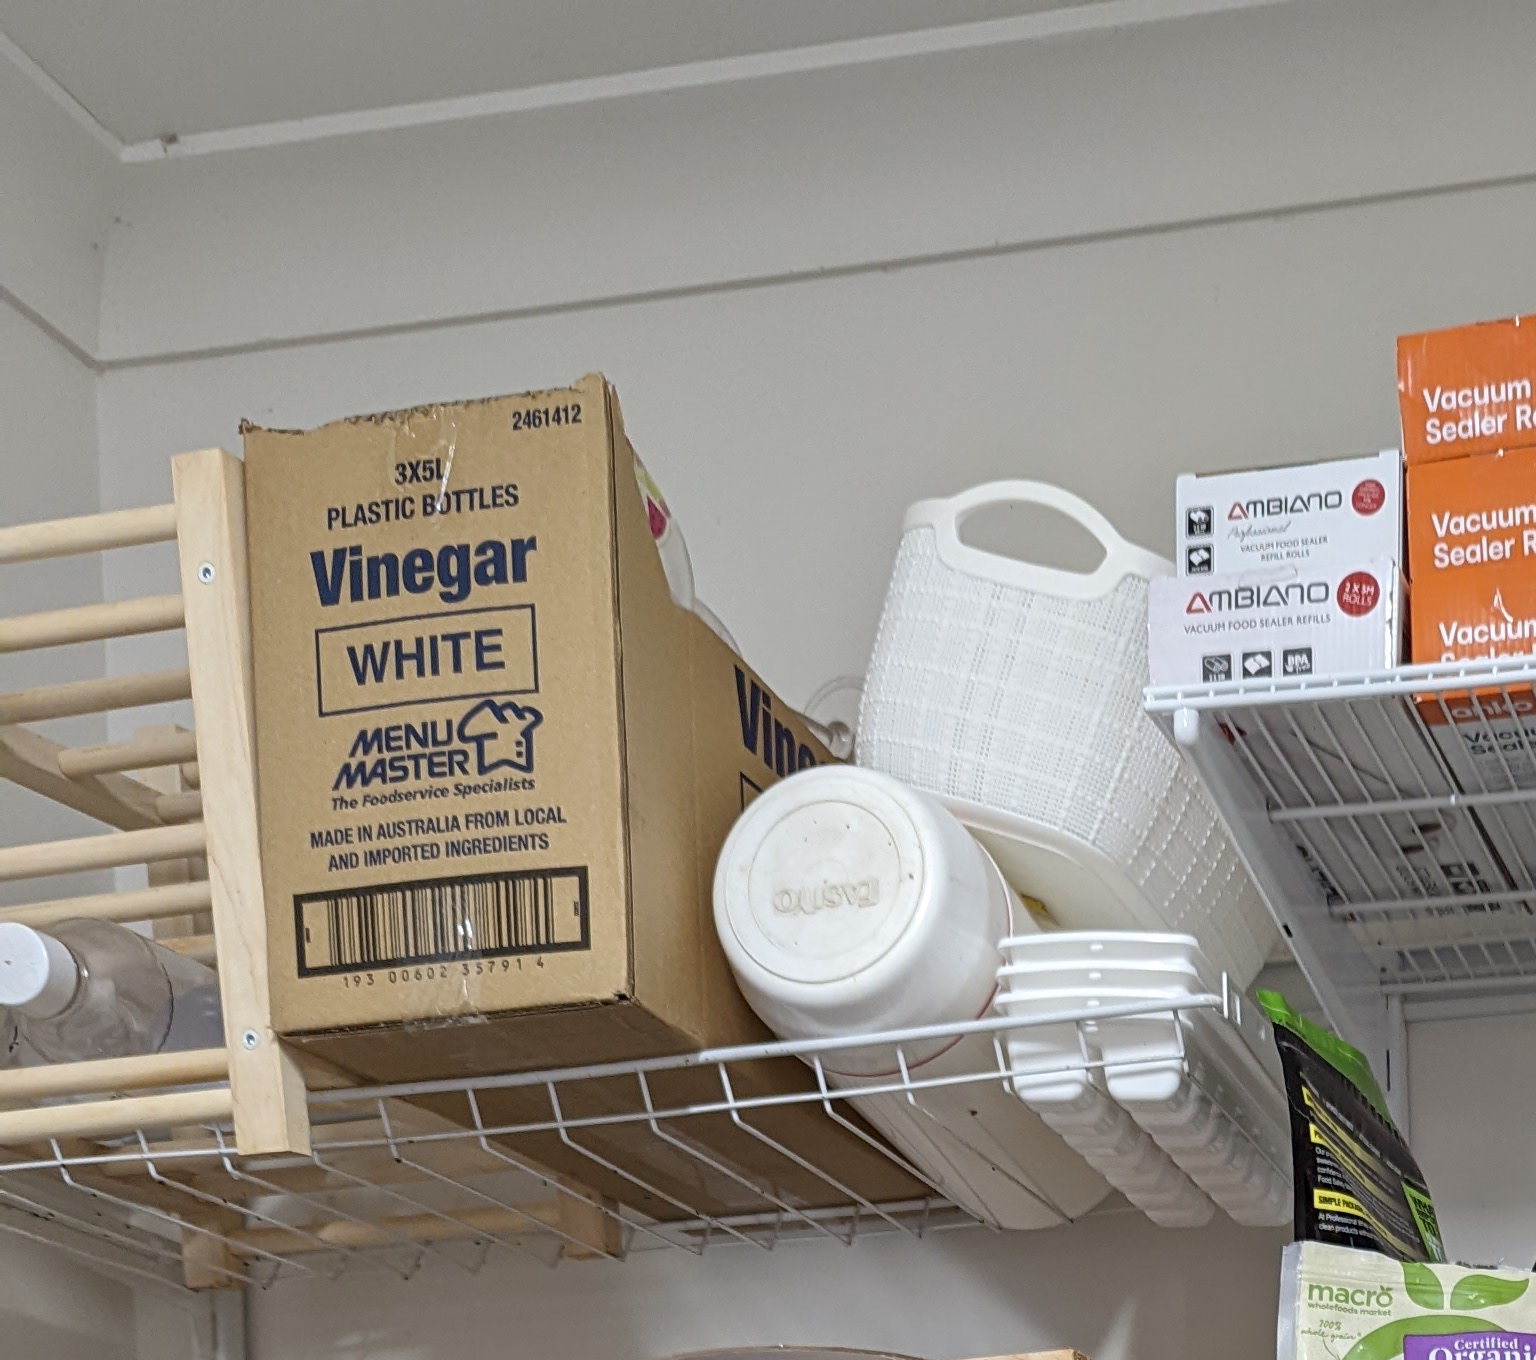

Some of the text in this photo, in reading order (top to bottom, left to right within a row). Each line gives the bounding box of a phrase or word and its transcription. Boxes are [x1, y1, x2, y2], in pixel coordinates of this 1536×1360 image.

[1423, 382, 1534, 414] Vacuum
[512, 403, 582, 431] 2461412
[1425, 411, 1508, 446] Sealer
[394, 457, 443, 485] 3X5L
[326, 484, 520, 532] PLASTIC BOTTLES
[1227, 490, 1343, 522] AMBIANO
[1301, 536, 1329, 548] SEALER
[1434, 535, 1518, 569] Sealer
[310, 533, 537, 607] Vinegar
[1186, 581, 1330, 616] AMBIANO
[1342, 592, 1373, 607] ROLLS
[1184, 612, 1332, 635] VACUUM FOOD SEALER REFILLS
[348, 627, 506, 687] WHITE
[349, 719, 453, 758] MENU
[332, 749, 470, 792] MASTER
[332, 777, 536, 812] The Foodservice Specialists
[310, 805, 568, 849] MADE IN AUSTRALIA FROM LOCAL
[328, 833, 550, 873] AND IMPORTED INGREDIENTS
[343, 973, 376, 989] 193
[388, 964, 449, 985] 00602
[535, 955, 545, 969] 4
[1308, 1284, 1394, 1308] macro
[1454, 1336, 1519, 1351] Certified
